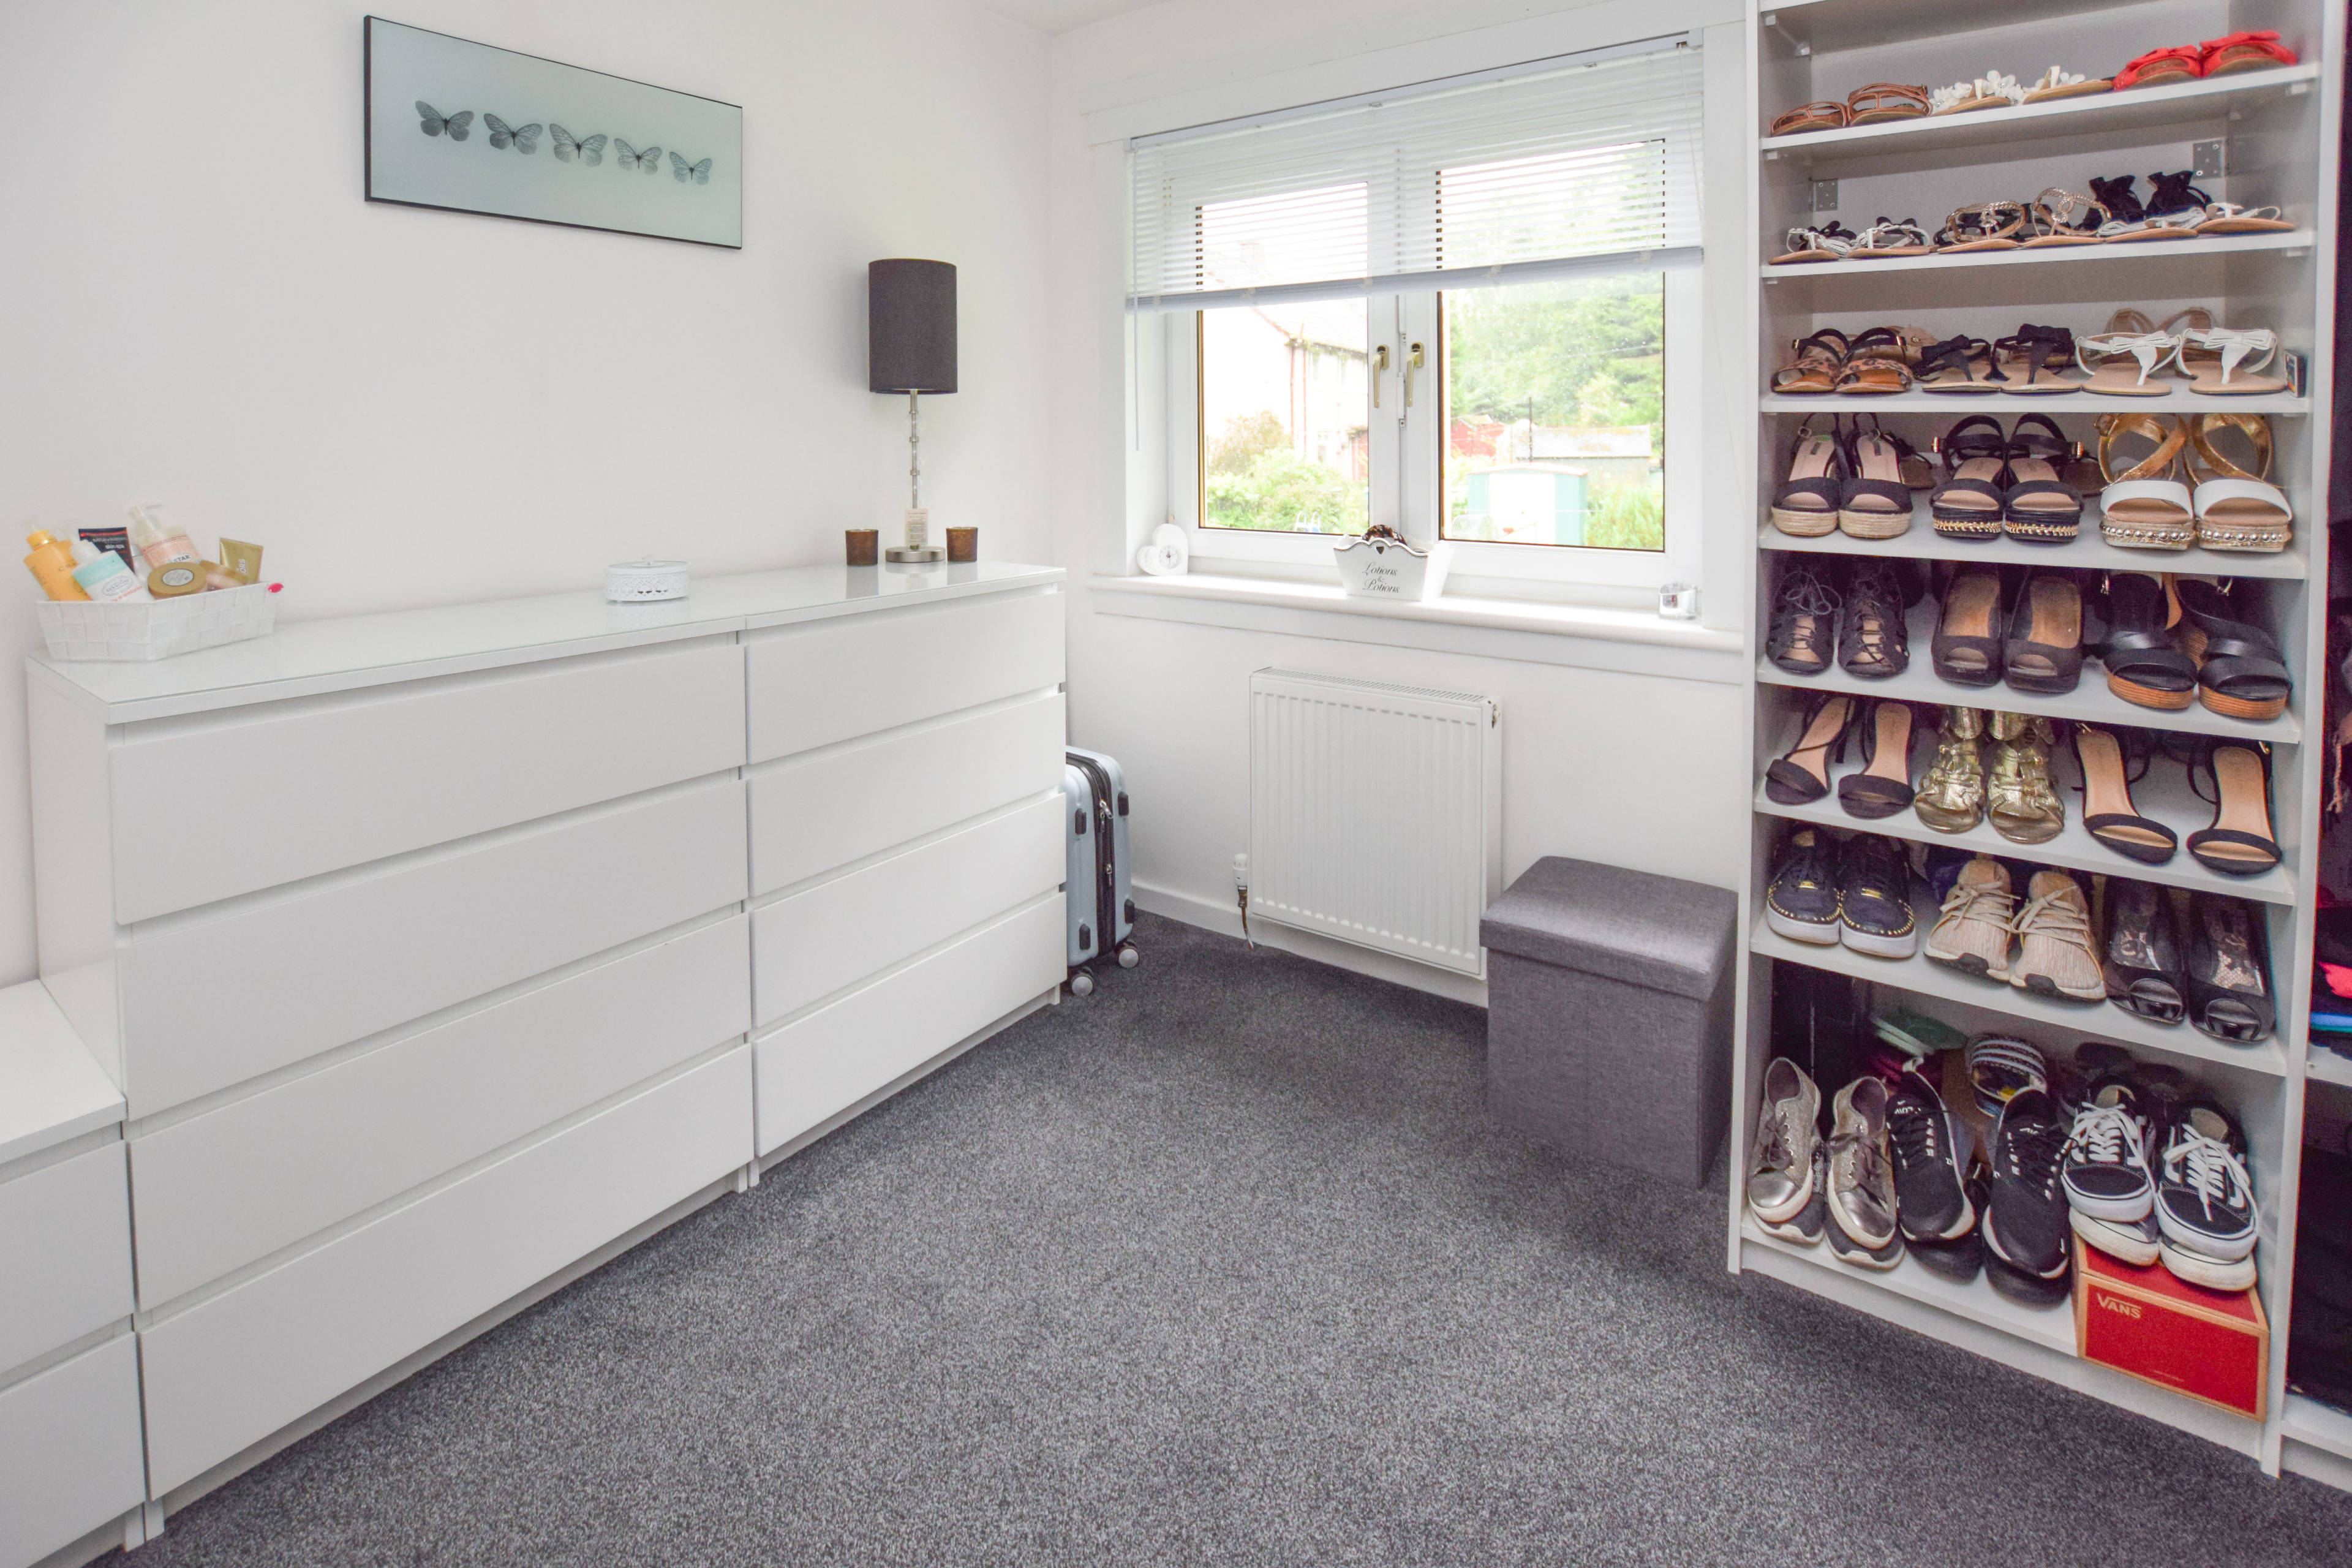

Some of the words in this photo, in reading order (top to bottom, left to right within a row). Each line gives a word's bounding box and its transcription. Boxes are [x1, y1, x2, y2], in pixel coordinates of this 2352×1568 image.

[1362, 562, 1398, 576] Lotions
[1362, 579, 1400, 594] Potions
[2096, 1293, 2142, 1319] VANS
